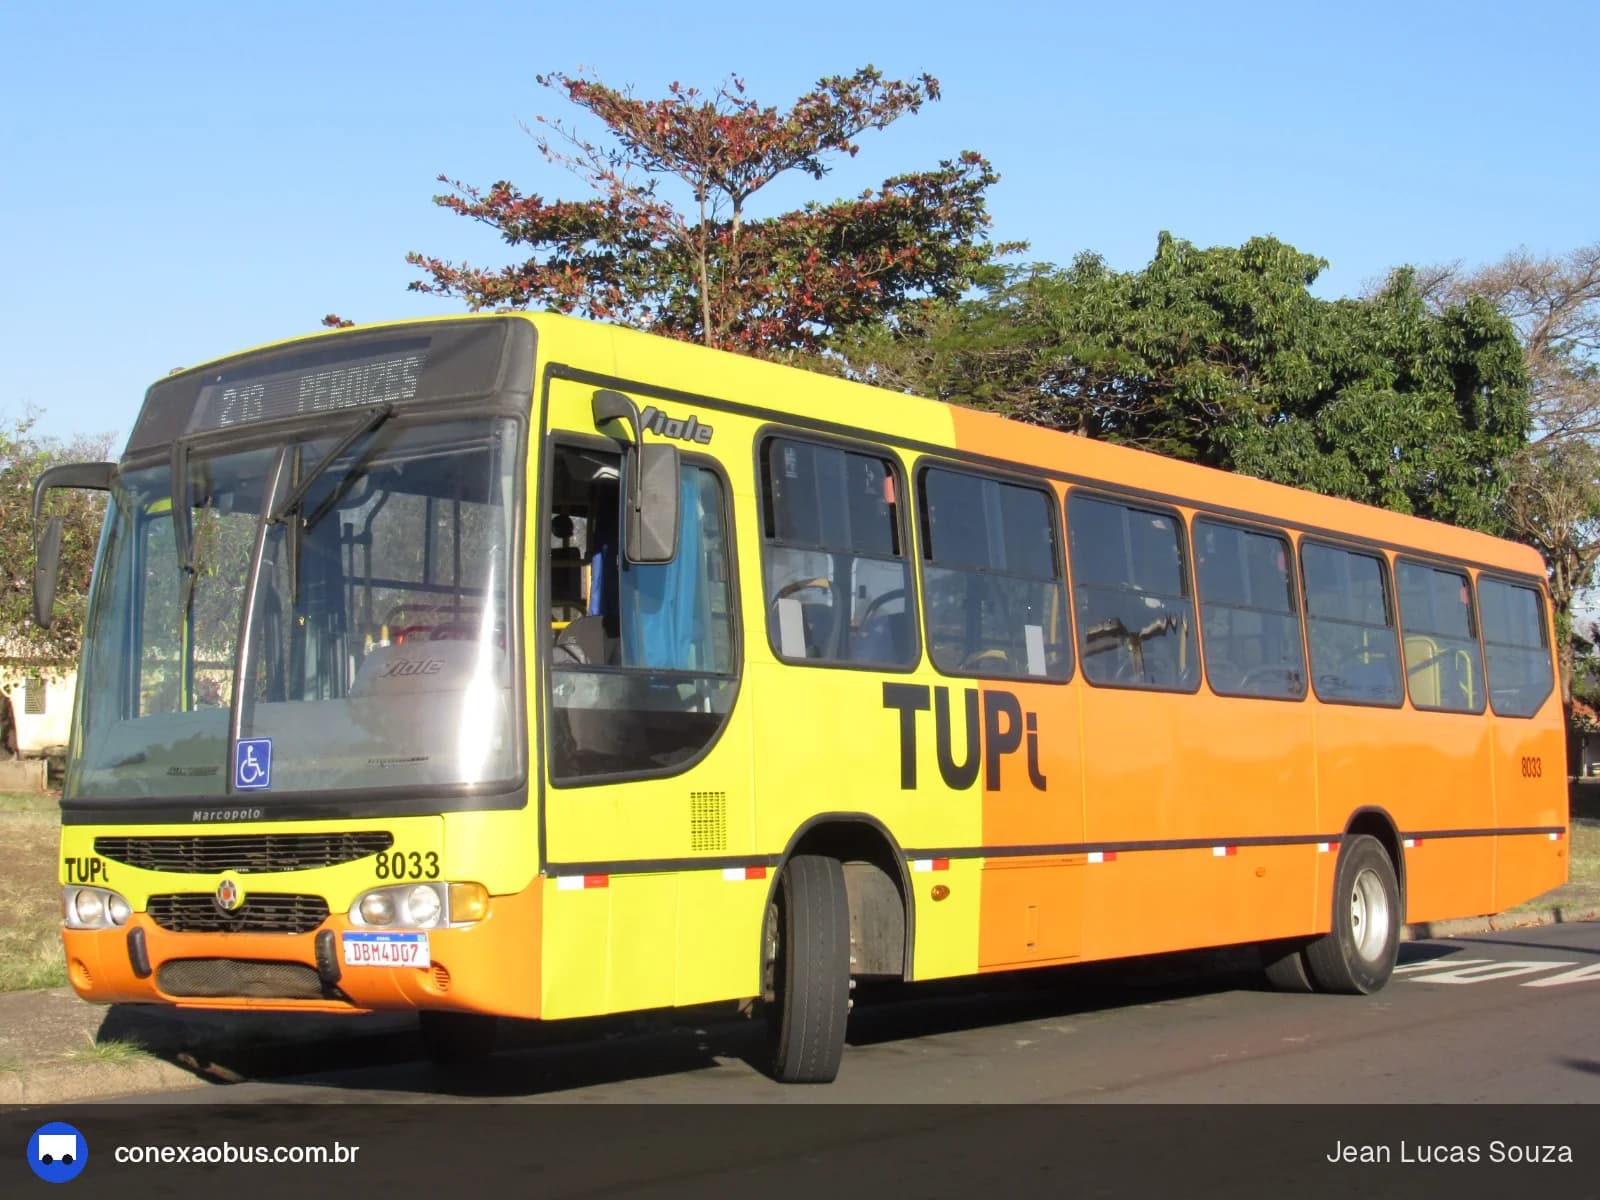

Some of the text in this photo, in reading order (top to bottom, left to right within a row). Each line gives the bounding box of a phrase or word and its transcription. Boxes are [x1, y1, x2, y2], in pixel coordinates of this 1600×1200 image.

[882, 681, 1047, 792] TUPi
[1521, 757, 1542, 778] 8033
[192, 808, 261, 821] Marcopolo
[65, 857, 109, 882] TUPi
[375, 851, 440, 879] 8033
[353, 943, 418, 962] DBM4D07
